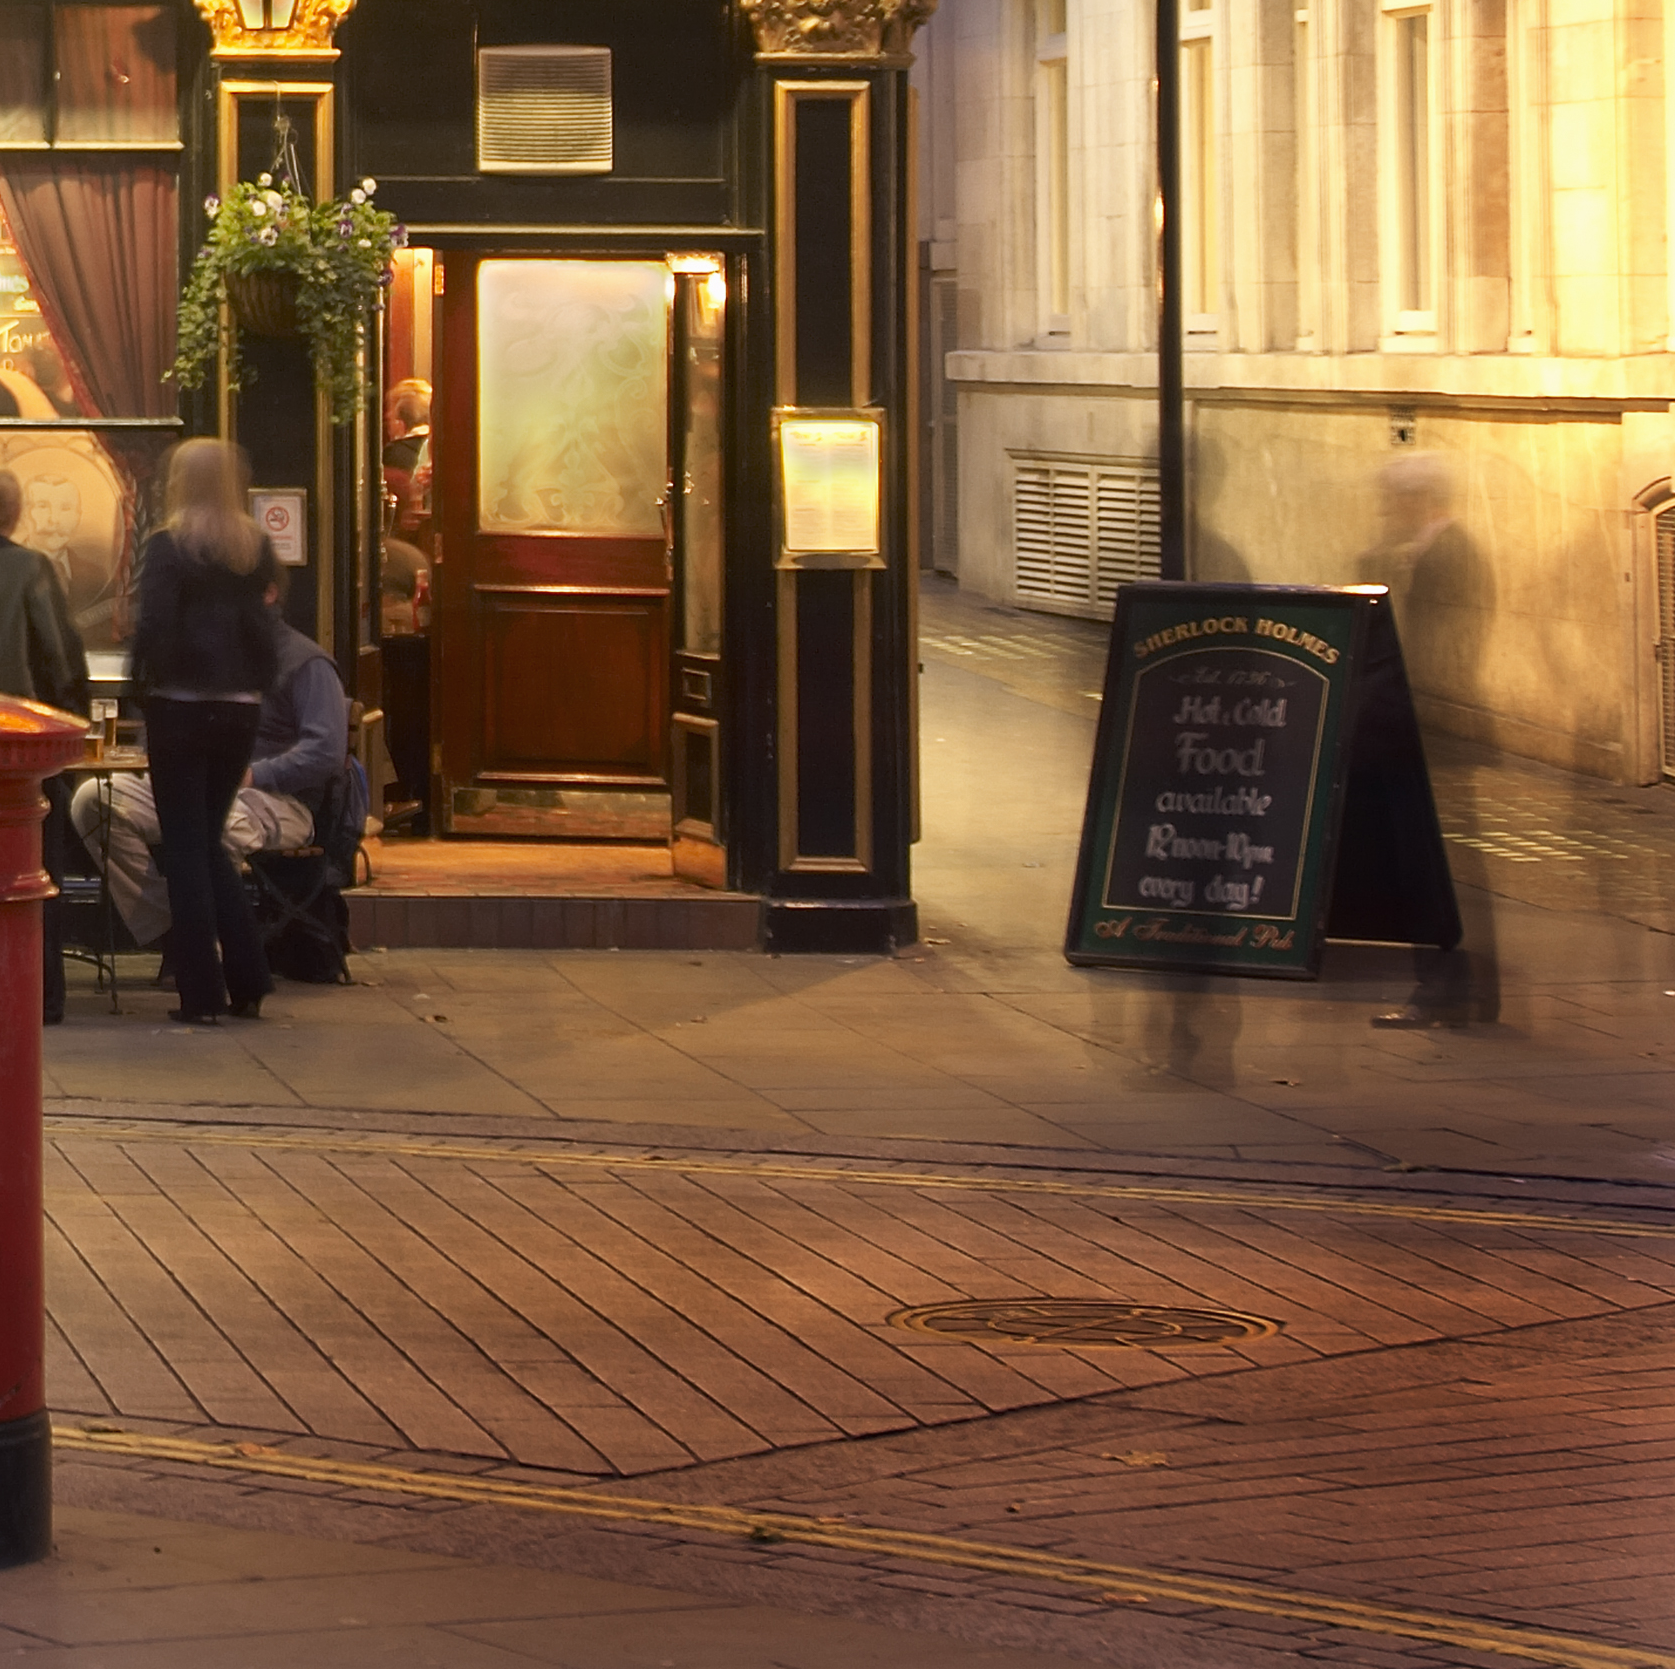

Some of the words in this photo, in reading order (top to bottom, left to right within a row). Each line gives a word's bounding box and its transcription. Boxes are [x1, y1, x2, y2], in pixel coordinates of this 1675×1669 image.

[1133, 616, 1249, 659] SHERLOCK
[1254, 617, 1341, 665] HOLMES
[1175, 732, 1266, 777] Food
[1155, 786, 1273, 817] available
[1138, 876, 1195, 909] every
[1204, 874, 1266, 911] day!
